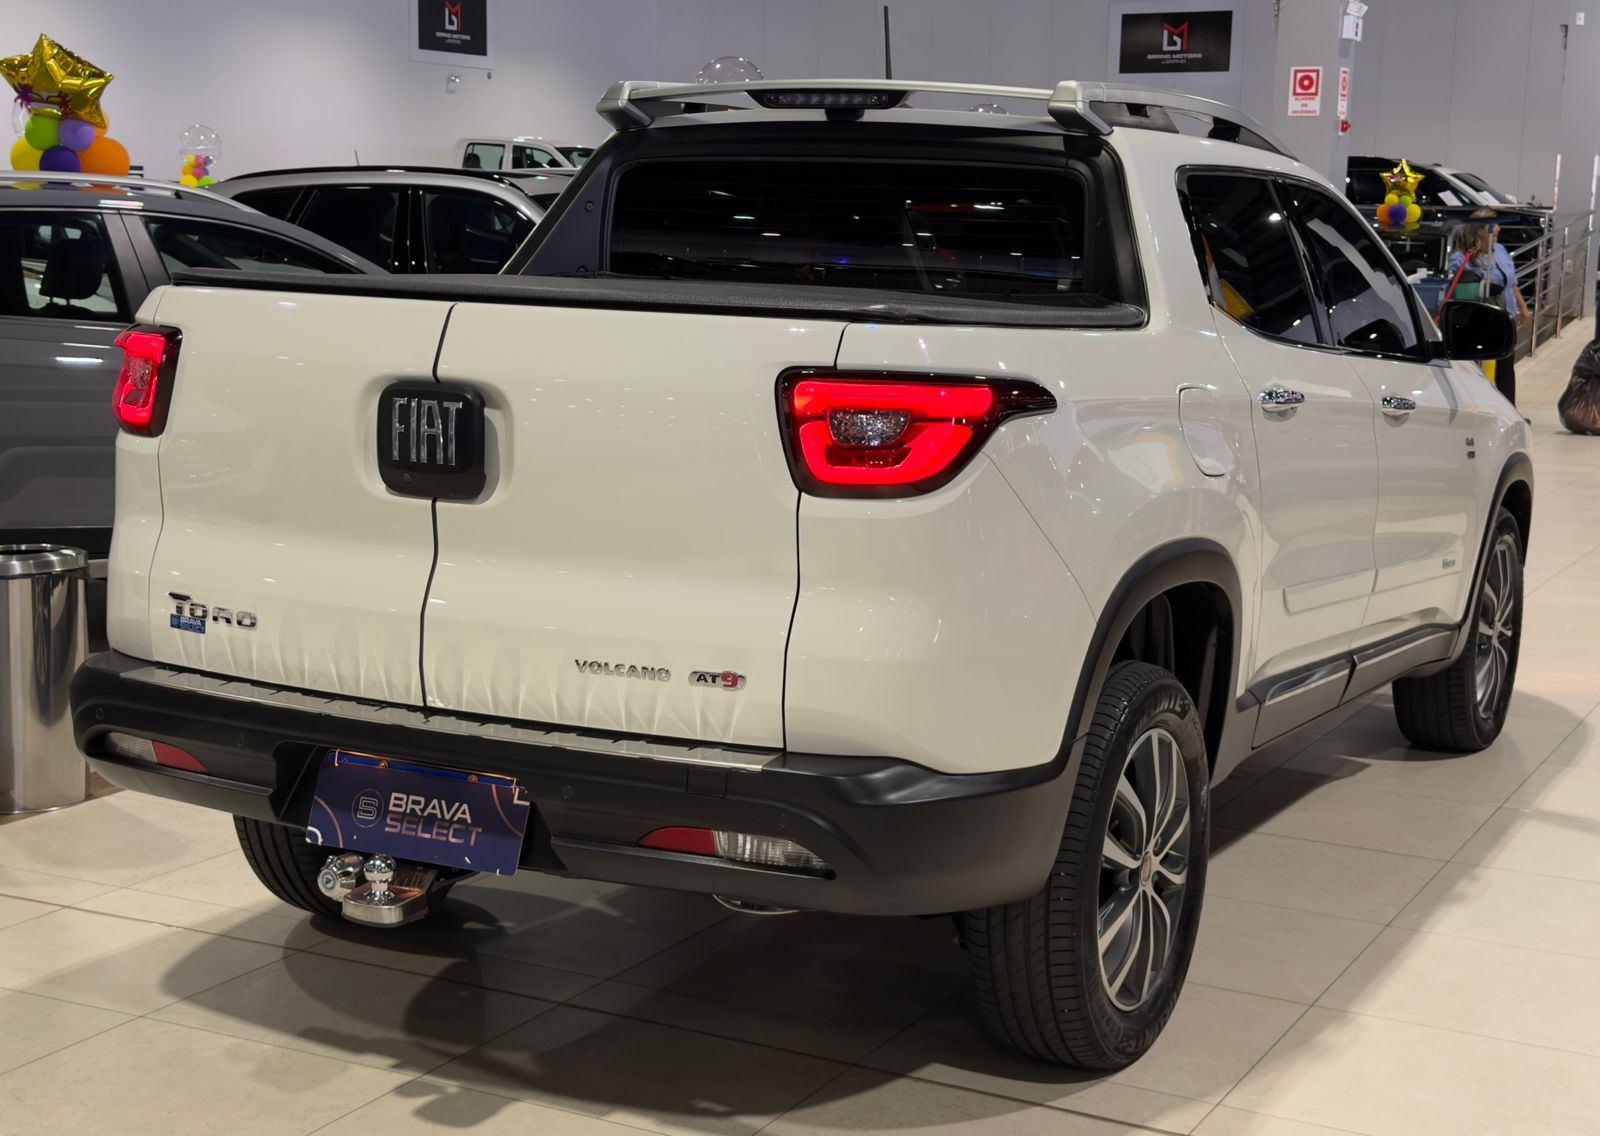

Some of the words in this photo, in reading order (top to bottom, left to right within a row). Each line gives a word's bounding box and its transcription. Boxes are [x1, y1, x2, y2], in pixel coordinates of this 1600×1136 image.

[391, 397, 464, 466] FIAT
[167, 592, 257, 629] TORO
[179, 615, 203, 627] BRAVA
[574, 658, 672, 682] VOLCANO
[695, 670, 740, 690] AT9
[387, 791, 472, 824] BRAVA
[383, 812, 483, 847] SELECT
